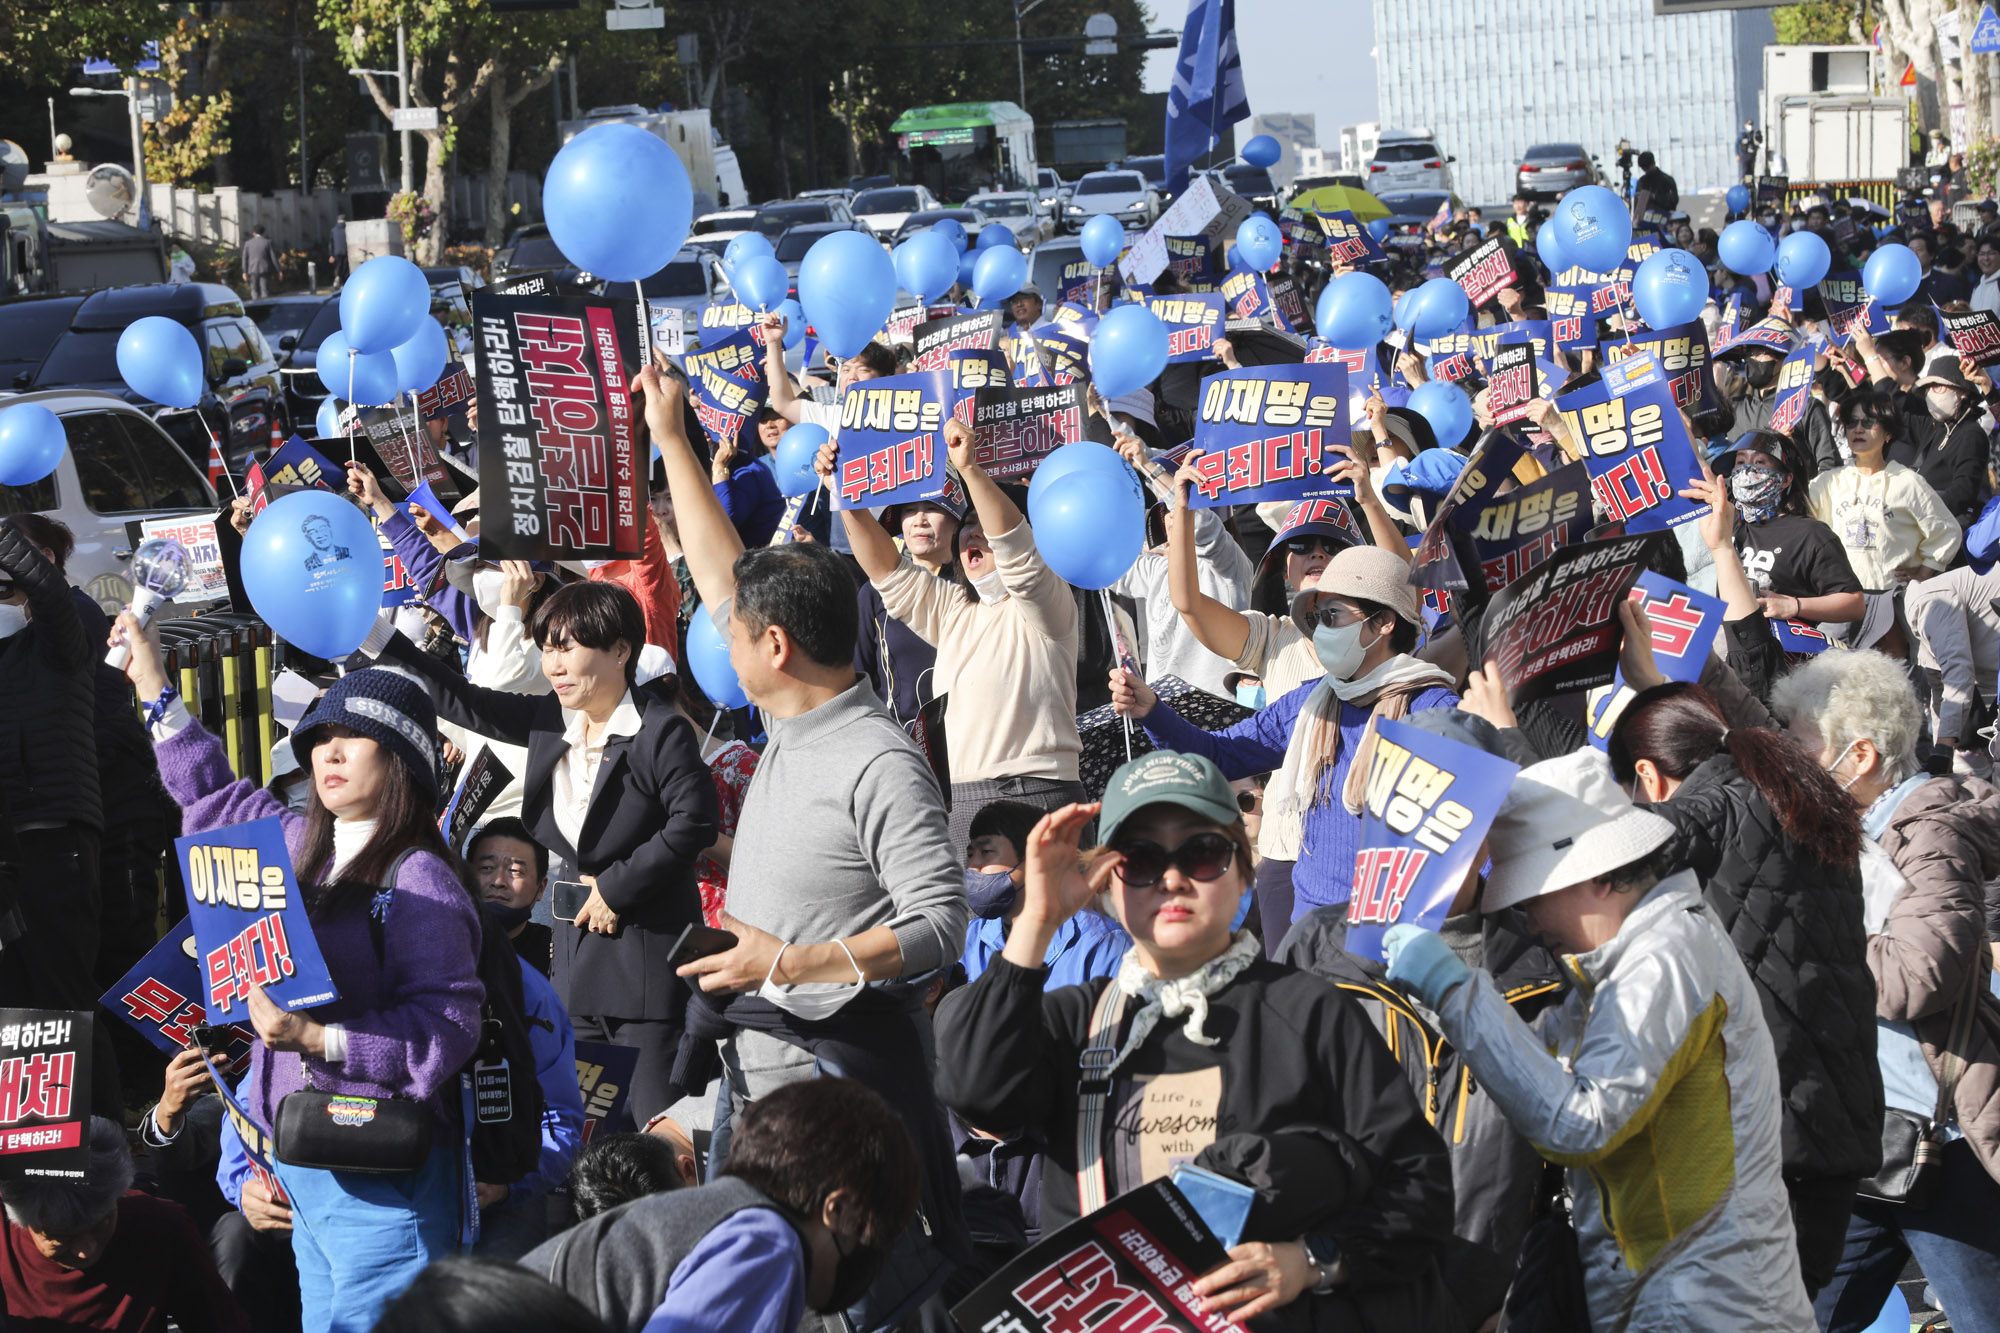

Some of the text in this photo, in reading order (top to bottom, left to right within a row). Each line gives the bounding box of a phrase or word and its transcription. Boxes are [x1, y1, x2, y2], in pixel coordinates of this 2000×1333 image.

[1459, 247, 1511, 300] 찰해체
[951, 314, 994, 340] 탄핵하라!
[1151, 299, 1220, 326] 이재명은
[1552, 316, 1582, 344] 다!
[656, 329, 680, 347] 다!
[702, 365, 760, 418] 이재명은
[841, 389, 943, 432] 이재명은
[976, 389, 1077, 422] 정치검찰 탄핵하라!
[1202, 379, 1339, 428] 이재명은
[482, 316, 541, 537] 정치검찰 탄핵하라!
[513, 312, 611, 549] 검찰해체
[597, 327, 634, 528] 김건희 수사검사 전원 탄핵하라!
[699, 402, 746, 439] 무죄다!
[974, 405, 1082, 466] 검찰해체
[841, 432, 935, 503] 무죄다!
[1197, 428, 1324, 501] 무죄다!
[1487, 570, 1550, 640] 정치검찰
[1549, 537, 1647, 589] 탄핵하라!
[1547, 635, 1600, 667] 탄핵하라!
[355, 699, 401, 727] SUN
[1145, 755, 1174, 769] NEW
[1173, 757, 1207, 782] YORK
[189, 844, 288, 911] 이재명은
[206, 911, 295, 1013] 무죄다!
[0, 1019, 72, 1051] 핵하라!
[1111, 1096, 1240, 1146] Awesome
[1150, 1092, 1202, 1109] Life is
[7, 1129, 63, 1150] 탄핵하라!
[1160, 1139, 1195, 1154] with
